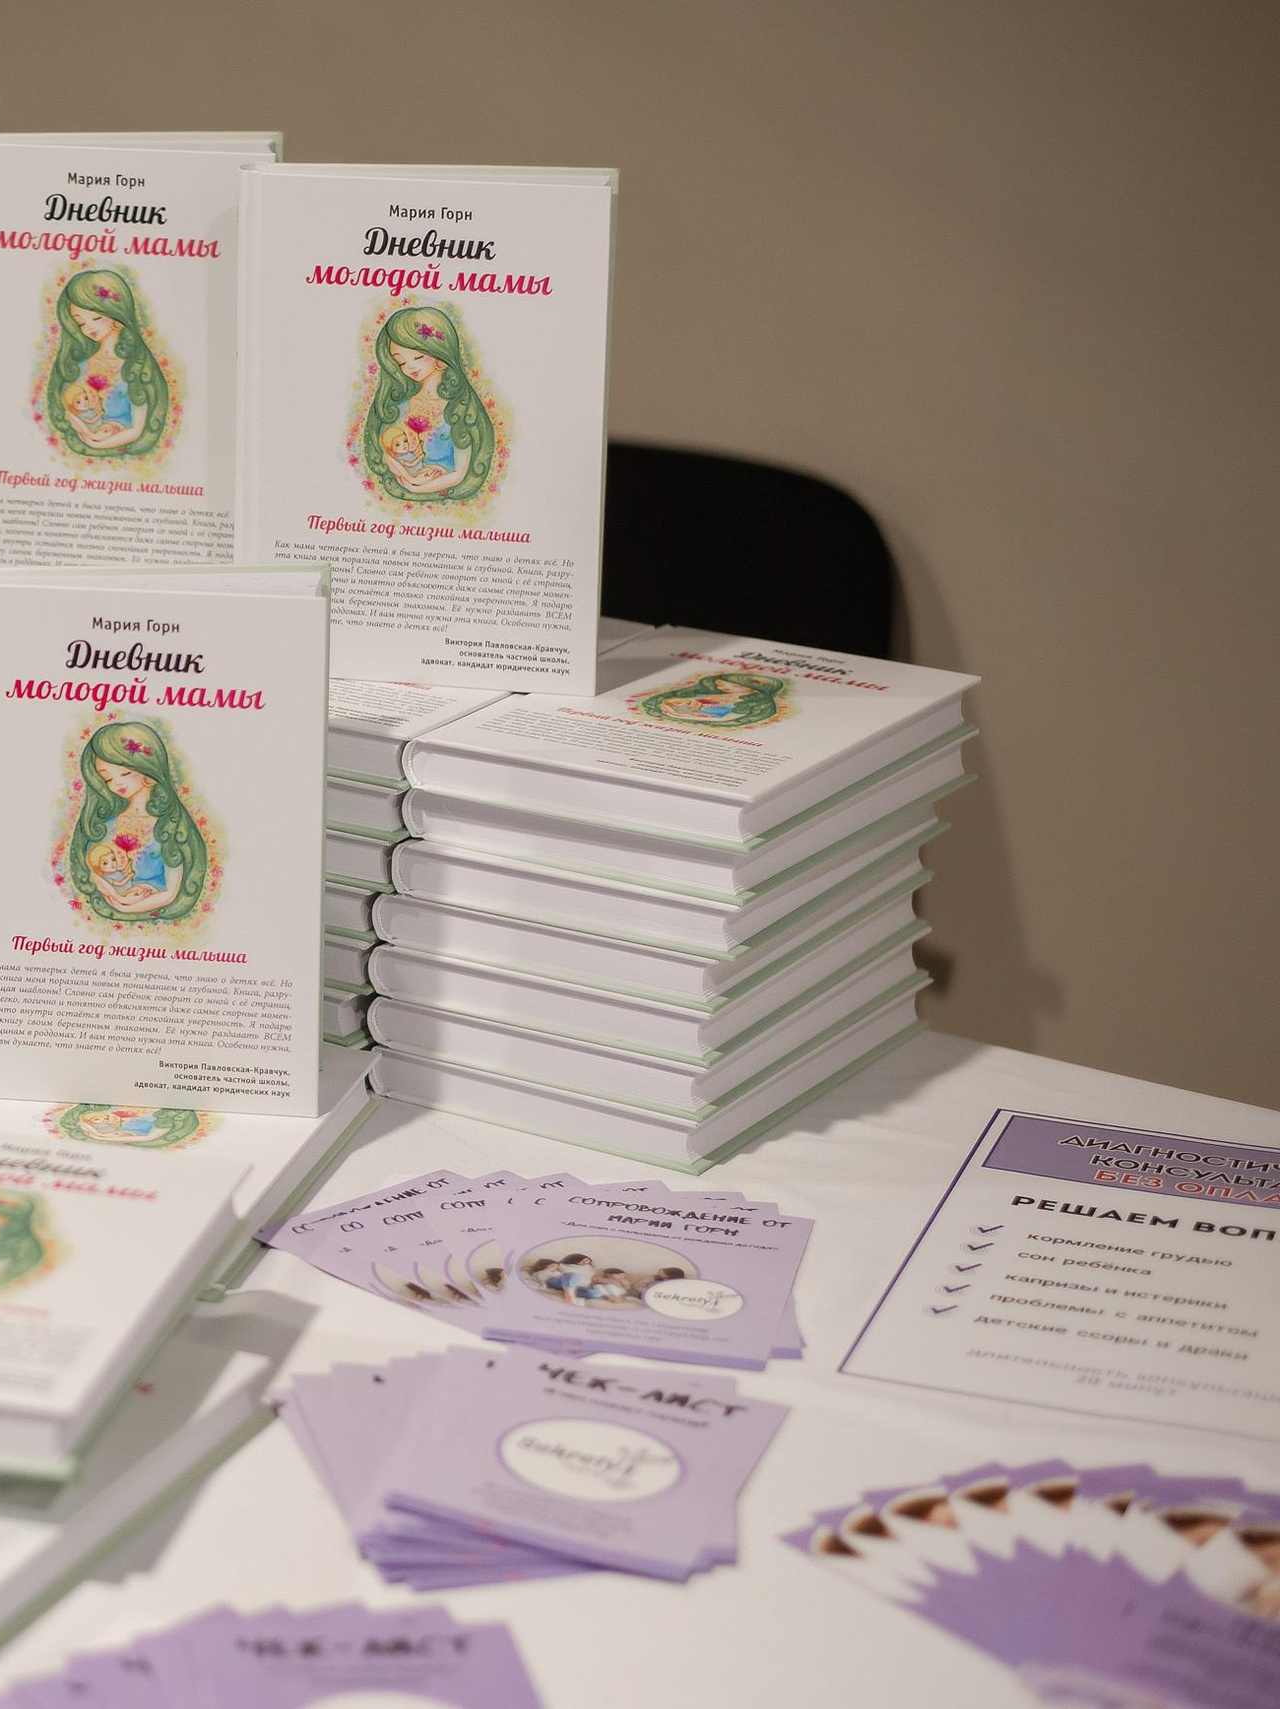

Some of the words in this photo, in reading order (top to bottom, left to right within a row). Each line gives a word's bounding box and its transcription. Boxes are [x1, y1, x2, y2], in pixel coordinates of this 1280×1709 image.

[68, 172, 110, 187] Мария
[116, 174, 144, 189] Горн
[44, 193, 166, 224] Дневник
[389, 204, 434, 220] Мария
[441, 207, 471, 223] Горн
[124, 236, 220, 258] мамы
[363, 227, 496, 262] Дневник
[305, 262, 442, 297] молодой
[448, 272, 552, 295] мамы
[54, 478, 78, 492] год
[81, 479, 132, 494] жизни
[136, 483, 203, 496] малыша
[307, 515, 366, 534] Первый
[370, 523, 395, 538] год
[399, 525, 454, 540] жизни
[458, 529, 530, 543] малыша
[92, 617, 140, 633] Мария
[147, 619, 179, 635] Горн
[65, 639, 205, 675] Дневник
[445, 638, 482, 647] Виктория
[485, 640, 569, 654] Павловская-Кравчук,
[421, 658, 454, 666] адвокат,
[496, 664, 548, 672] юридических
[540, 654, 569, 664] школы,
[5, 675, 149, 711] молодой
[156, 686, 264, 709] мамы
[12, 935, 74, 955] Первый
[78, 944, 105, 959] год
[108, 946, 166, 961] жизни
[170, 950, 247, 963] малыша
[24, 966, 67, 975] четверых
[70, 966, 97, 977] детей
[109, 968, 131, 977] была
[134, 972, 170, 981] уверена,
[196, 976, 217, 985] знаю
[229, 976, 257, 985] детях
[280, 979, 292, 987] Но
[159, 1060, 198, 1070] Виктория
[201, 1063, 289, 1077] Павловская-Кравчук,
[174, 1073, 220, 1081] основатель
[134, 1081, 169, 1089] адвокат,
[172, 1084, 210, 1092] кандидат
[213, 1087, 268, 1095] юридических
[271, 1090, 290, 1098] наук
[1094, 1169, 1163, 1188] БЕЗ
[568, 1196, 752, 1225] СОПРОВОЖДЕНИЕ
[762, 1219, 792, 1229] ОТ
[1011, 1195, 1179, 1228] РЕШАЕМ
[608, 1214, 673, 1230] МАРИИ
[684, 1224, 739, 1237] ГОРН
[1027, 1234, 1144, 1254] кормление
[1151, 1251, 1232, 1266] грудью
[1018, 1252, 1054, 1261] сон
[1062, 1258, 1151, 1275] ребёнка
[1004, 1274, 1098, 1291] капризы
[1123, 1290, 1226, 1309] истерики
[973, 1315, 1067, 1334] детские
[990, 1294, 1103, 1314] проблемы
[1136, 1315, 1257, 1337] аппетитом
